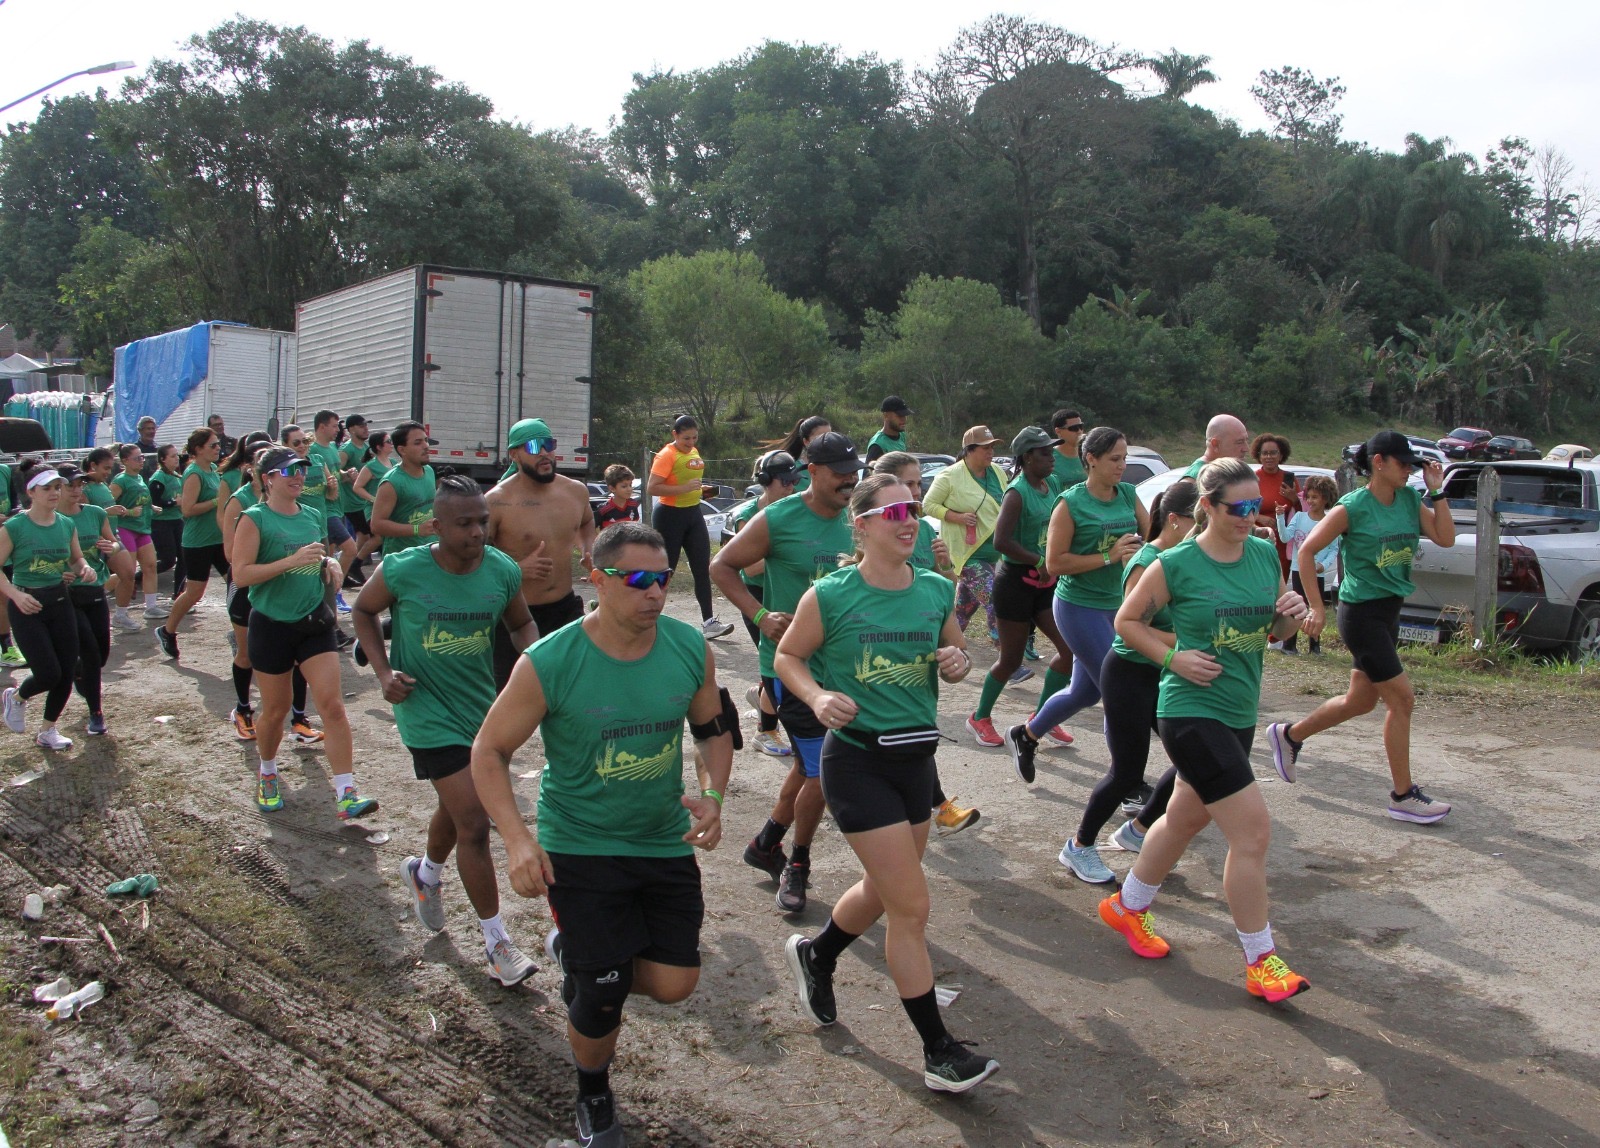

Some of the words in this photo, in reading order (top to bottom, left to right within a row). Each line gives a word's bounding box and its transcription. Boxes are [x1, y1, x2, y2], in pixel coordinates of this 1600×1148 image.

[813, 555, 838, 564] CIRCU
[428, 612, 467, 621] CIRCUITO
[1215, 606, 1252, 617] CIRCUITO
[1254, 605, 1273, 615] RURA
[859, 632, 905, 644] CIRCUITO
[907, 631, 933, 642] RURAL
[1400, 627, 1434, 641] MS6H53
[601, 723, 652, 741] CIRCUITO
[655, 718, 681, 733] RURA
